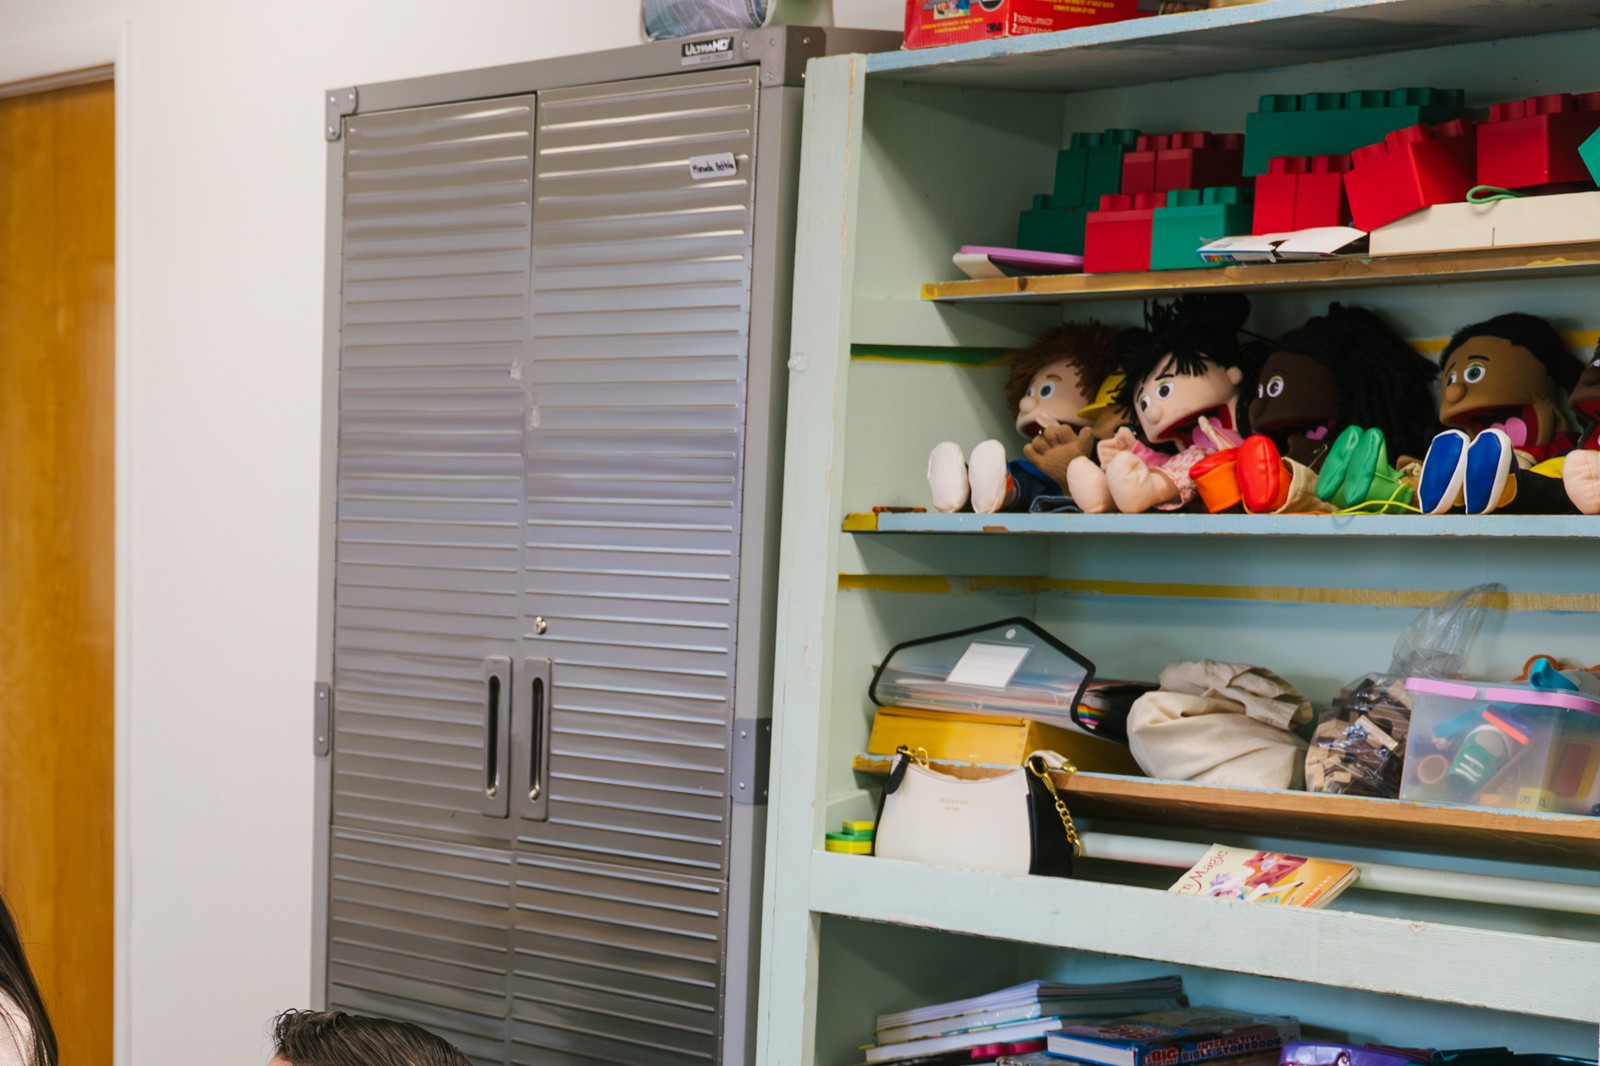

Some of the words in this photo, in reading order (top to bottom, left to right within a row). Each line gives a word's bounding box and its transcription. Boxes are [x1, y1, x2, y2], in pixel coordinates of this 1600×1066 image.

[986, 22, 1002, 33] 3M
[1181, 1047, 1215, 1062] BIBLE
[1216, 1037, 1282, 1056] STORYBOOK
[1198, 1034, 1262, 1050] INTERACTIVE
[1152, 1048, 1179, 1062] BIG
